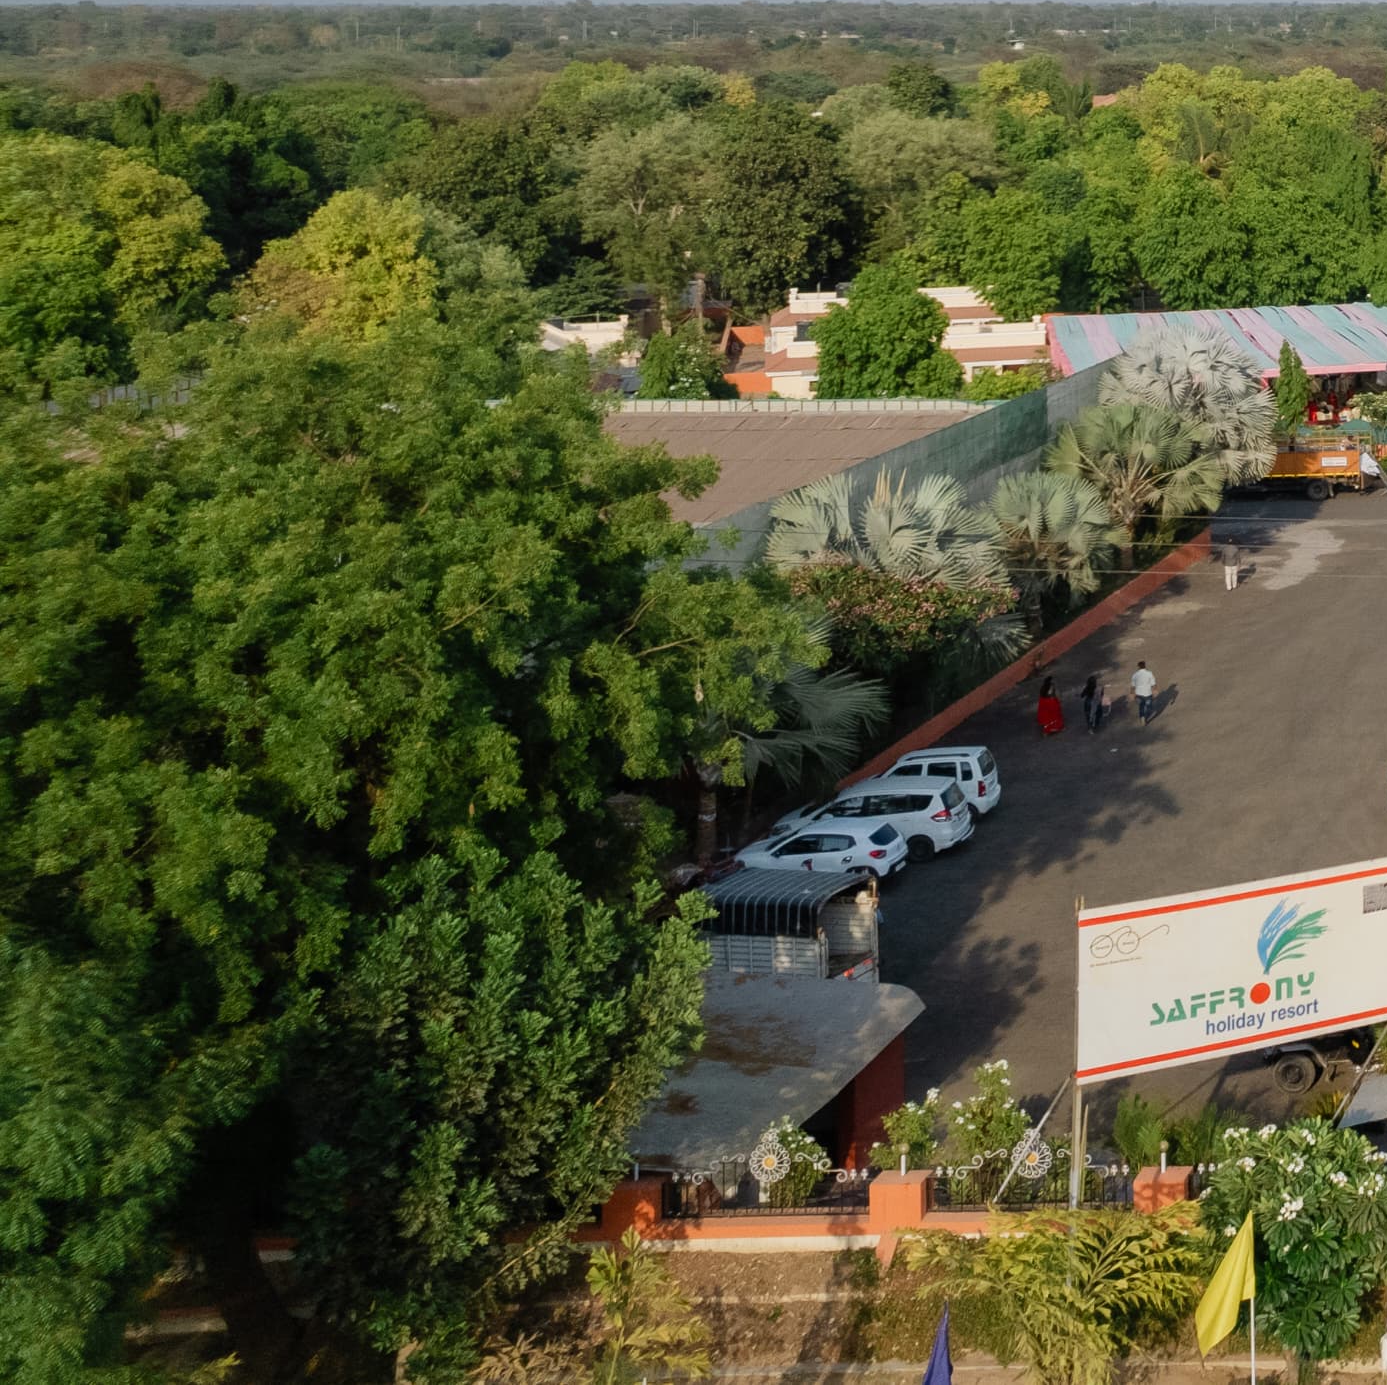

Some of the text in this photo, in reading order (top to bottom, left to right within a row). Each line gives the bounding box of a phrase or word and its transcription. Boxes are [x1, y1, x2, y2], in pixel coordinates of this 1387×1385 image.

[1150, 971, 1316, 1026] SAFFRONY
[1205, 998, 1319, 1036] holiday resort
